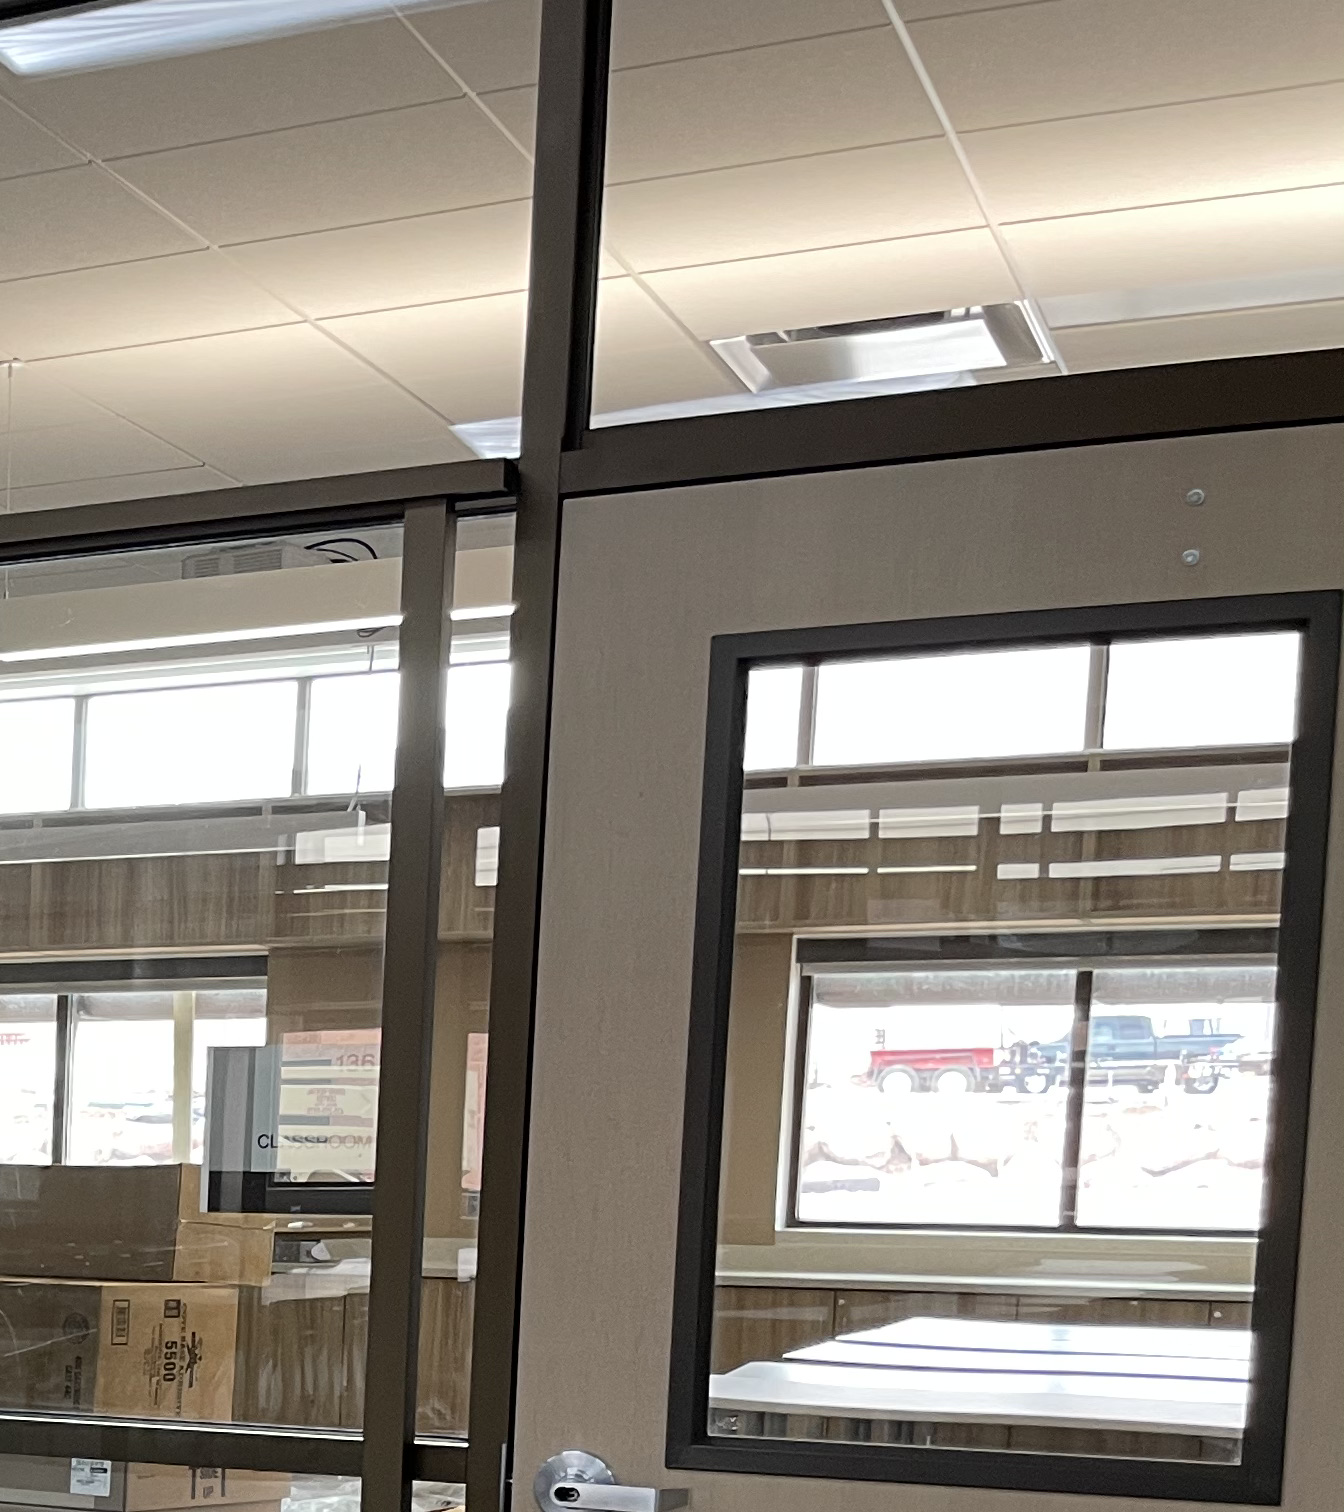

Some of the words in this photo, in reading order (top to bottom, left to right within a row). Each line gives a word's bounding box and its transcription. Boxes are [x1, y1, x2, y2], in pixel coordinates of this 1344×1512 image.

[257, 1133, 373, 1149] CLASSROOM
[162, 1340, 178, 1382] 5500
[202, 1485, 214, 1499] UP
